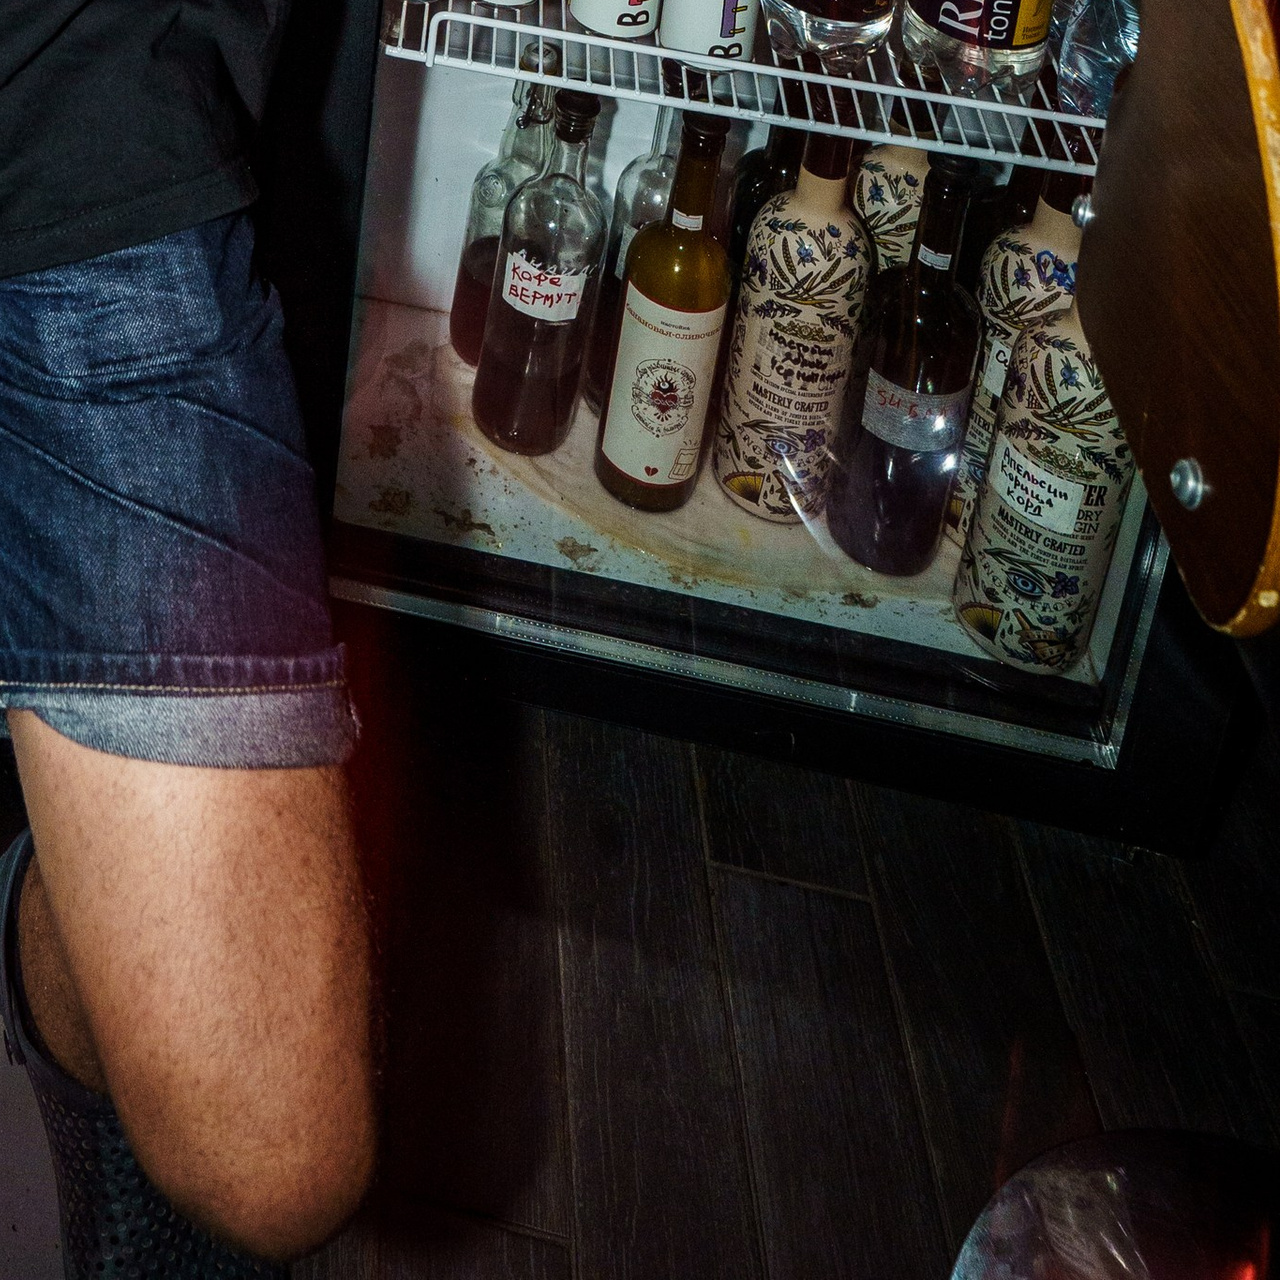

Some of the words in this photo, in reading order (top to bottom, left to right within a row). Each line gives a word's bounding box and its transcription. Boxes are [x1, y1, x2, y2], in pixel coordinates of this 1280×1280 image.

[507, 284, 578, 309] ВЕРМУТ
[752, 380, 794, 409] MASTERLY
[794, 400, 829, 413] CRAFTED
[1074, 521, 1101, 534] GIN
[1077, 509, 1103, 521] DRY
[997, 505, 1042, 544] MASTERLY
[1043, 536, 1086, 556] CRAFTED
